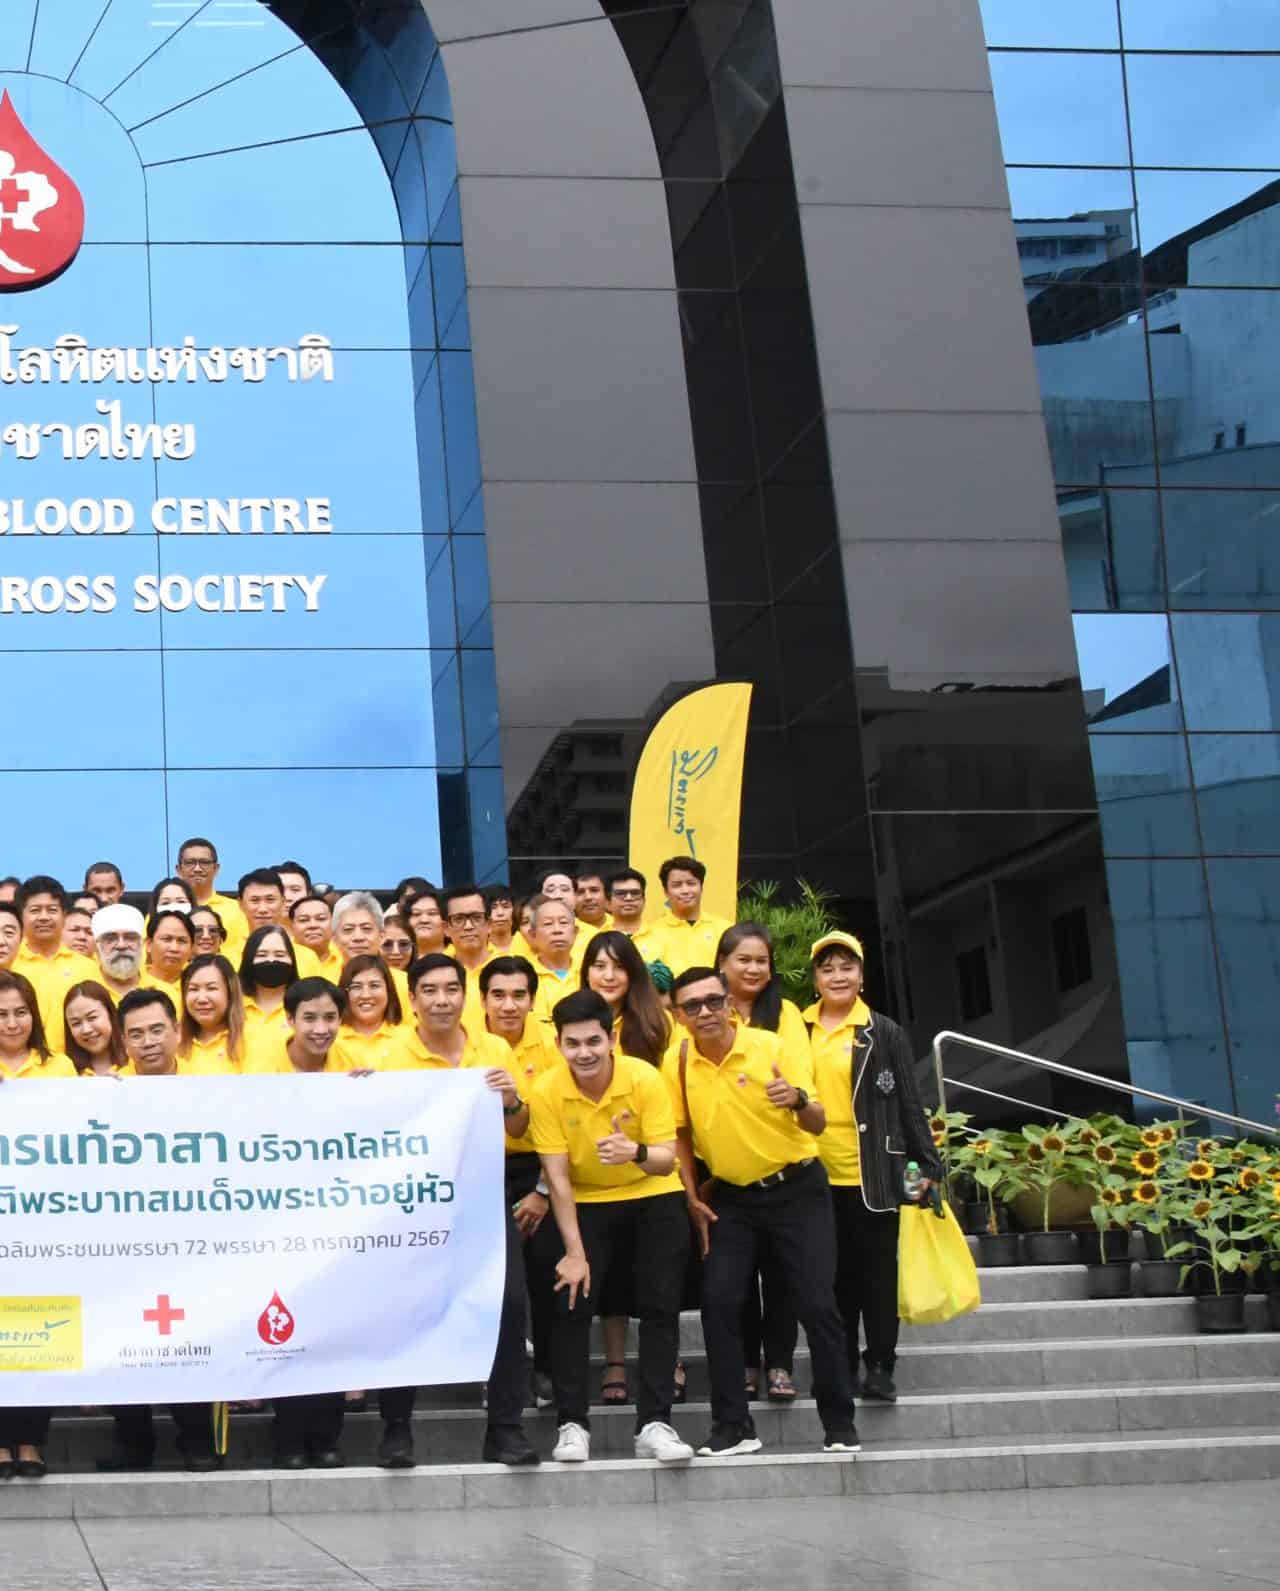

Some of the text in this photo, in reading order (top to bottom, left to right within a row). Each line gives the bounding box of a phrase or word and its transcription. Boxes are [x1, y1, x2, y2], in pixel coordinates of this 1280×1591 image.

[151, 496, 334, 535] CENTRE
[133, 574, 328, 613] SOCIETY
[239, 1130, 430, 1162] บริจาคโลหิต
[184, 1239, 207, 1256] 72
[213, 1238, 276, 1255] พรรษา
[281, 1236, 306, 1253] 28
[312, 1231, 402, 1253] กรกฎาคม
[407, 1230, 451, 1248] 2567
